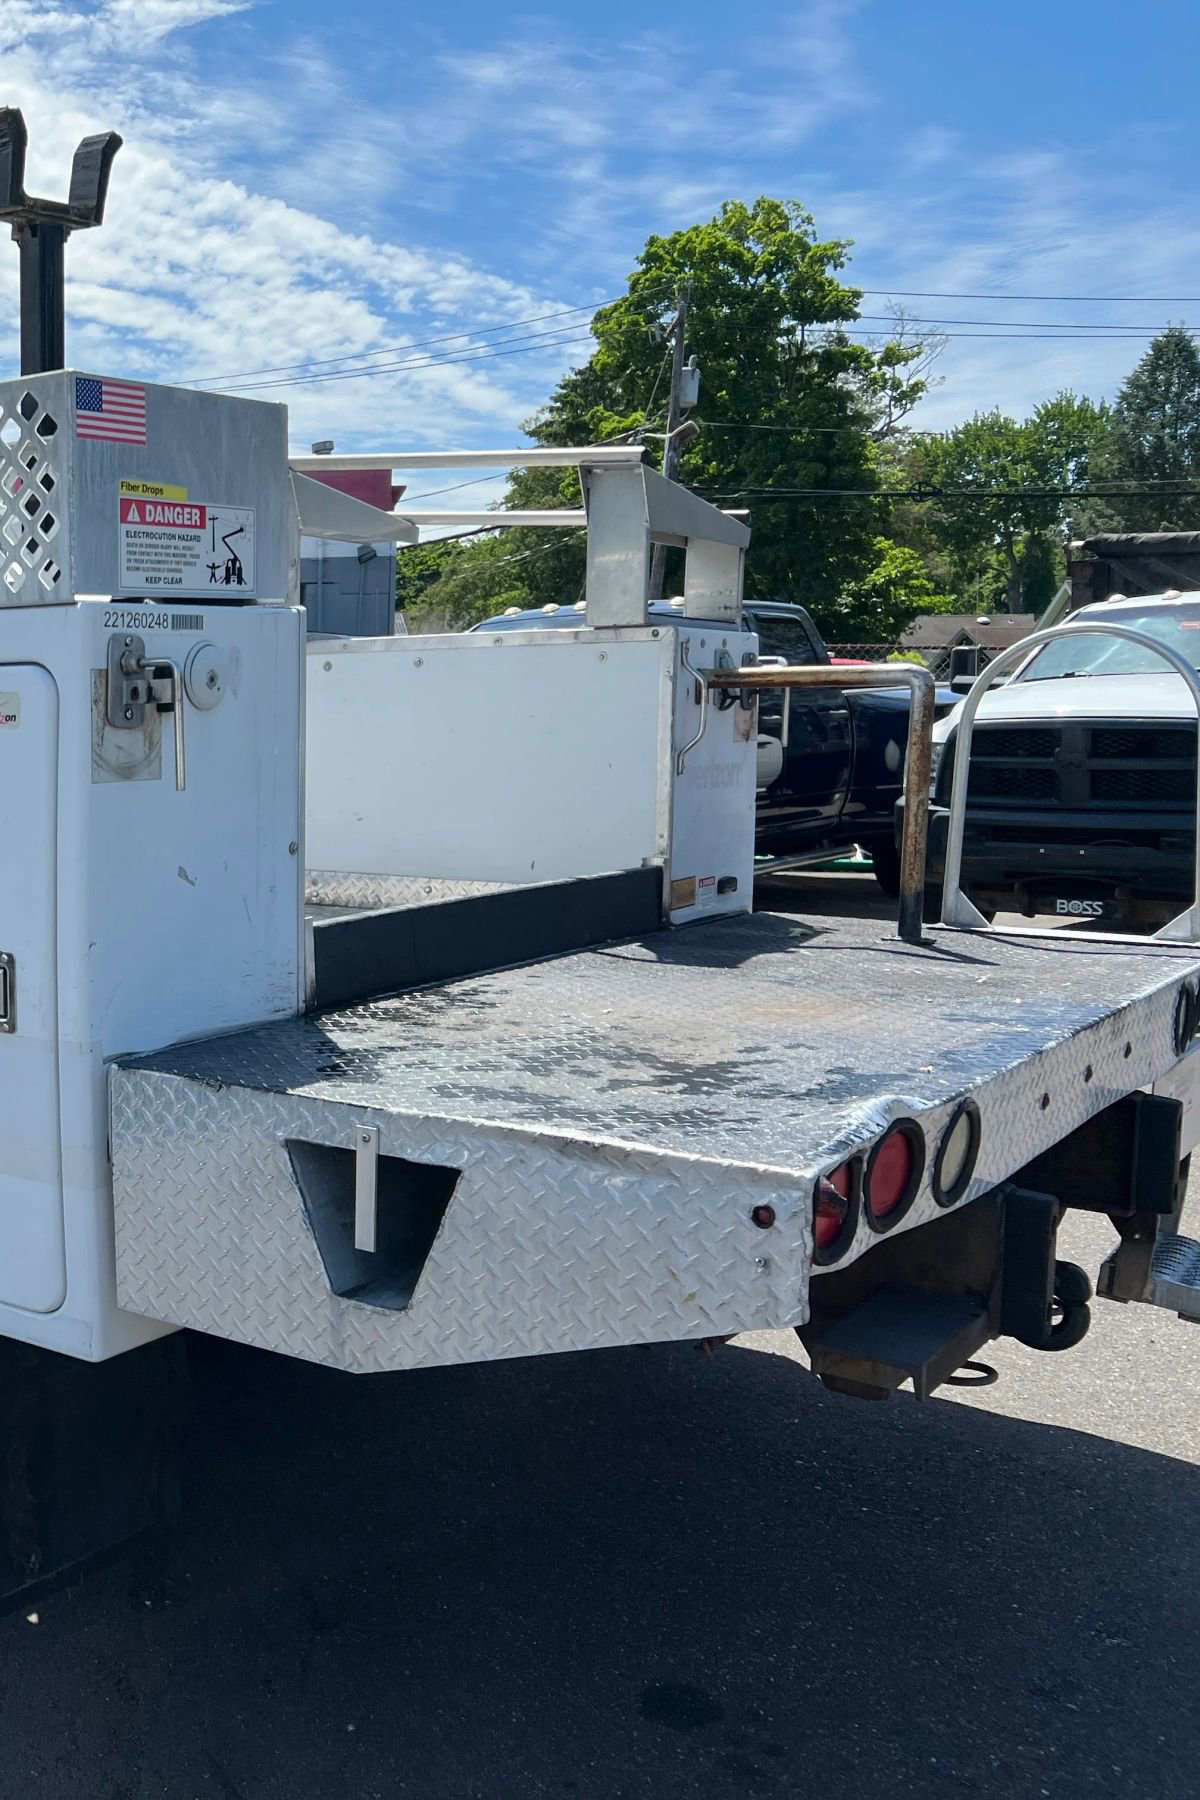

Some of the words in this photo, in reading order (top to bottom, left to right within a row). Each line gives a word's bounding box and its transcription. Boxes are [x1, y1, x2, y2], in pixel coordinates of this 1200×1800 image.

[120, 481, 140, 492] Fiber
[142, 484, 164, 496] Drops
[145, 504, 201, 526] DANGER
[125, 530, 177, 541] ELECTROCUTION
[177, 534, 201, 543] HAZARD
[145, 576, 162, 584] KEEP
[163, 577, 183, 585] CLEAR
[103, 611, 169, 629] 221260248
[1056, 899, 1103, 915] BOSS
